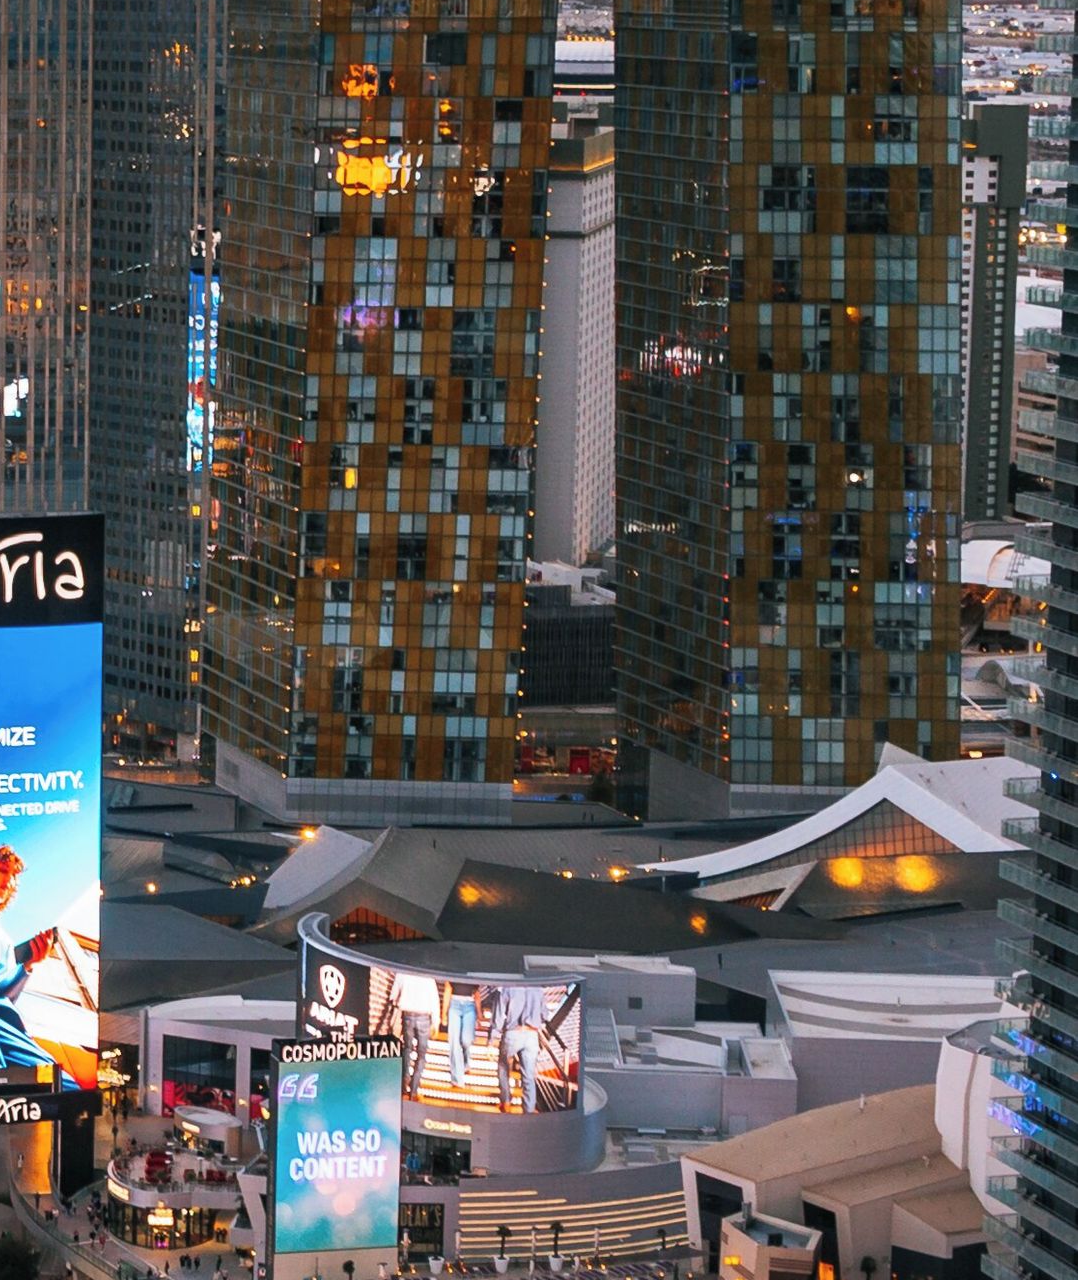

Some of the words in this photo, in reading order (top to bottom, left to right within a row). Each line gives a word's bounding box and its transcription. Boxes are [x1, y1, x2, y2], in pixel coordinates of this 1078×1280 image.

[45, 800, 80, 815] DRIVE
[330, 1031, 354, 1043] THE
[282, 1041, 401, 1063] COSMOPOLITAN
[297, 1130, 346, 1155] WAS
[351, 1128, 381, 1153] SO
[289, 1155, 387, 1181] CONTENT
